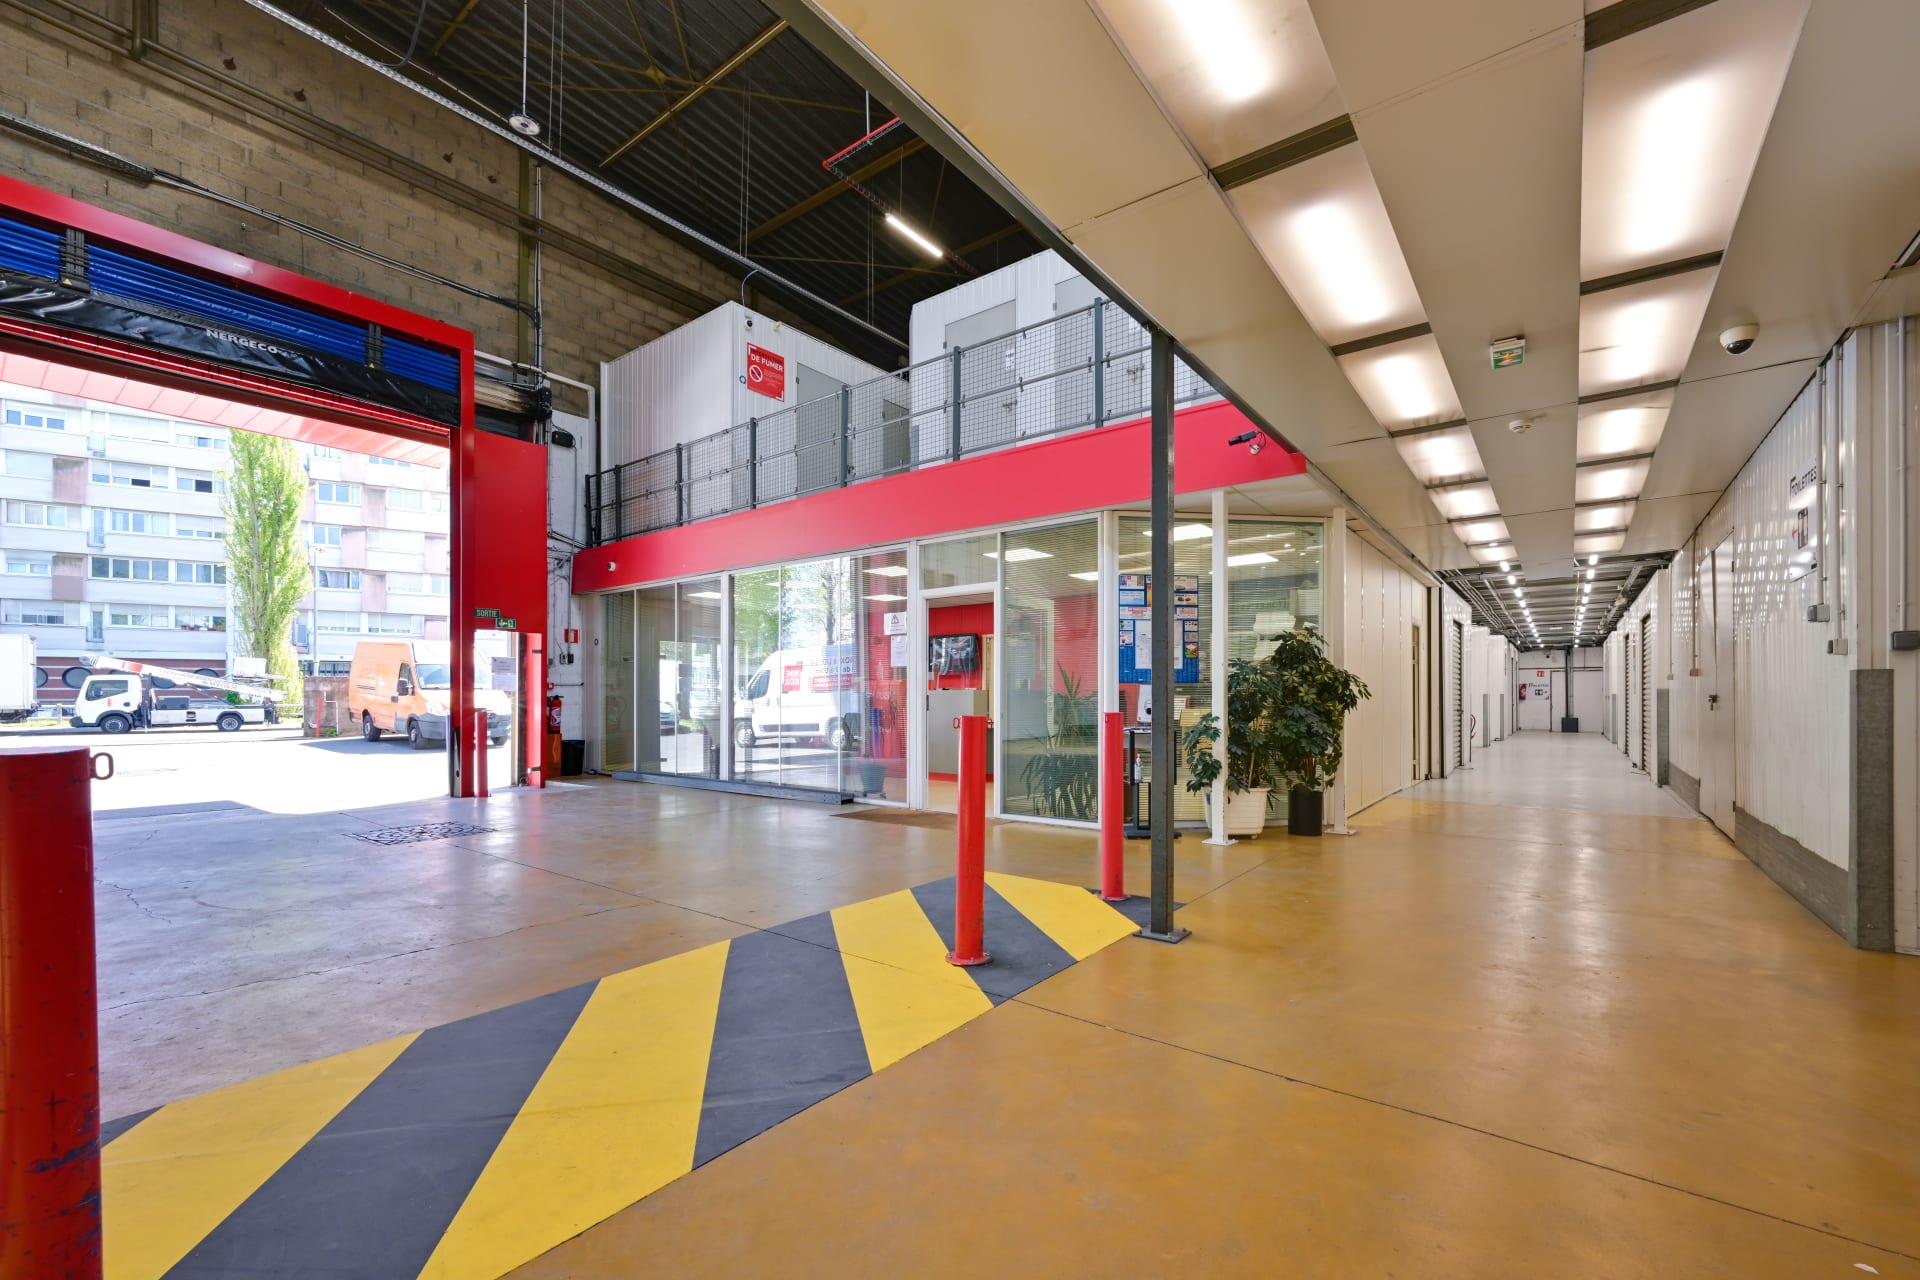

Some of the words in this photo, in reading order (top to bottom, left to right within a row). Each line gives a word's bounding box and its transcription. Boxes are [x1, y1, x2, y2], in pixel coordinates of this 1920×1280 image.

[206, 328, 278, 354] NERGECO
[751, 354, 760, 363] DE
[761, 357, 783, 372] FUMER
